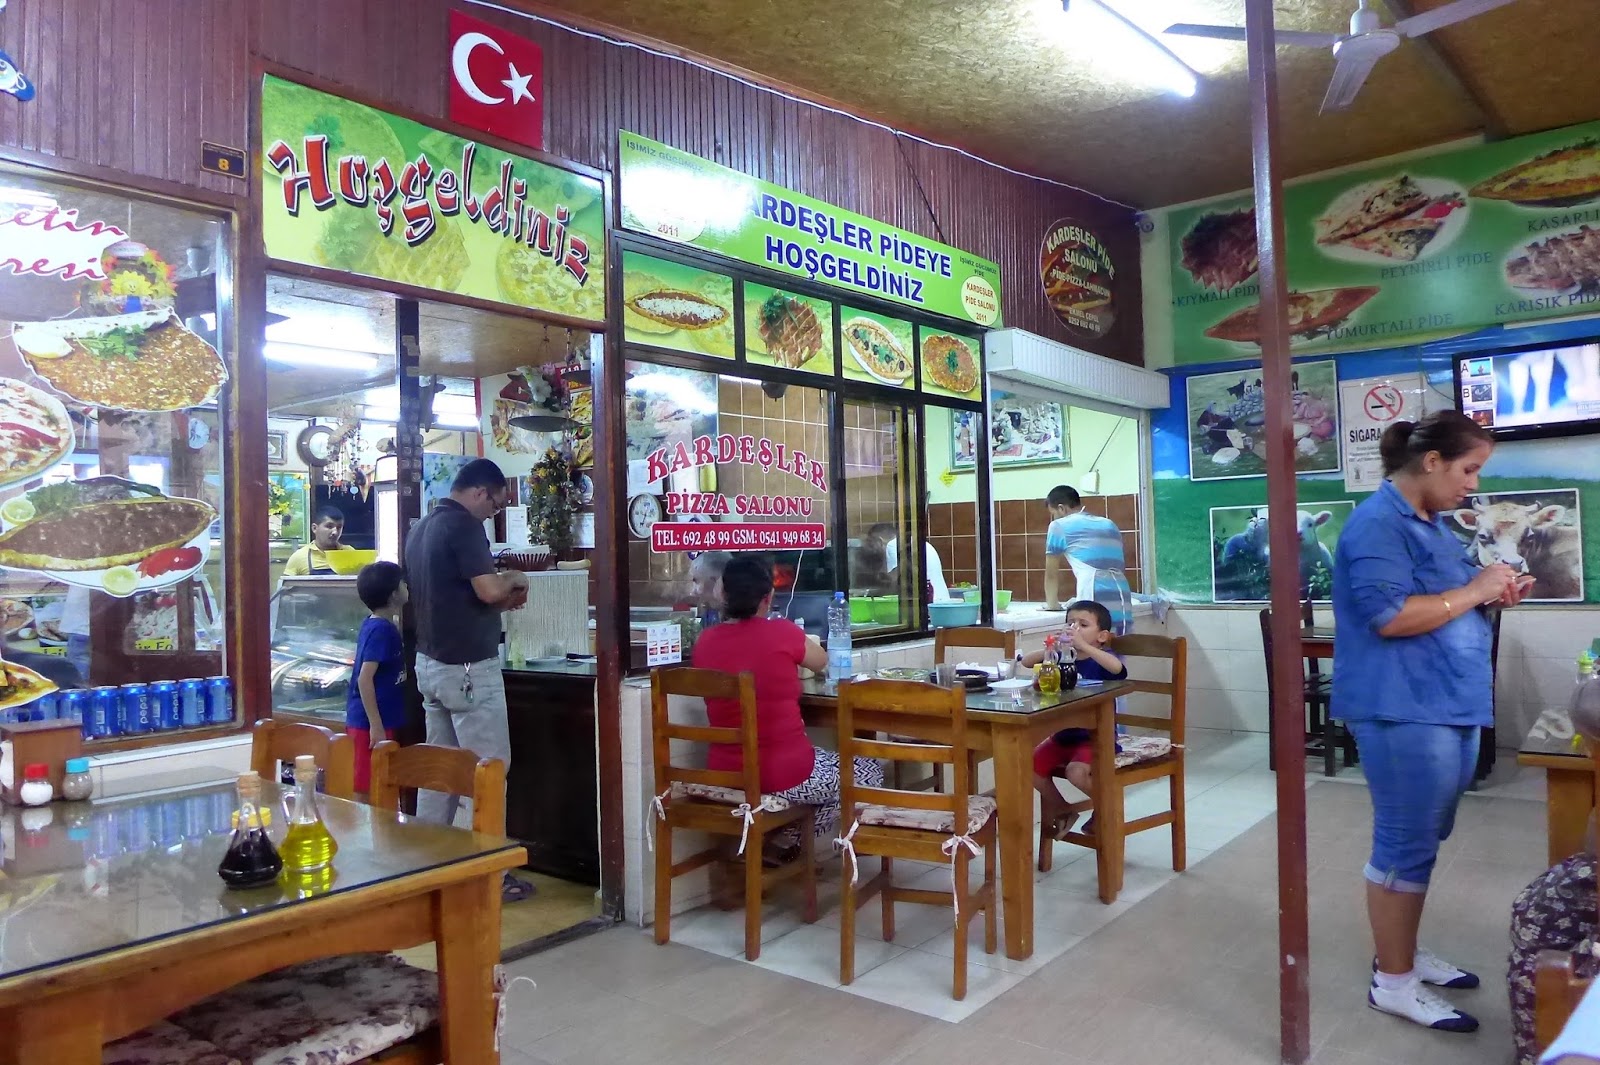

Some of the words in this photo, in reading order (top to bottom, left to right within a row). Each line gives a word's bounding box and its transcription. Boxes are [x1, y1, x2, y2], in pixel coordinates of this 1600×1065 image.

[218, 158, 230, 171] 8
[267, 134, 590, 286] Hoşgeldiniz
[657, 221, 679, 238] 2011
[747, 193, 873, 244] ARDEŞLER
[880, 233, 952, 278] PİDEYE
[765, 235, 924, 304] HOŞGELDİNİZ
[1064, 248, 1098, 273] SALONU
[977, 300, 996, 312] SALONU
[1461, 363, 1470, 374] A
[1463, 388, 1471, 399] B
[646, 433, 828, 493] KARDEŞLER
[666, 487, 731, 515] PİZZA
[734, 493, 813, 516] SALONU
[655, 529, 681, 546] TEL:
[682, 530, 701, 546] 692
[703, 530, 716, 547] 48
[718, 530, 730, 546] 99
[731, 529, 758, 545] GSM:
[759, 530, 780, 546] 0541
[782, 530, 798, 546] 949
[799, 529, 811, 544] 68
[811, 530, 823, 545] 34
[138, 692, 149, 724] pepsi
